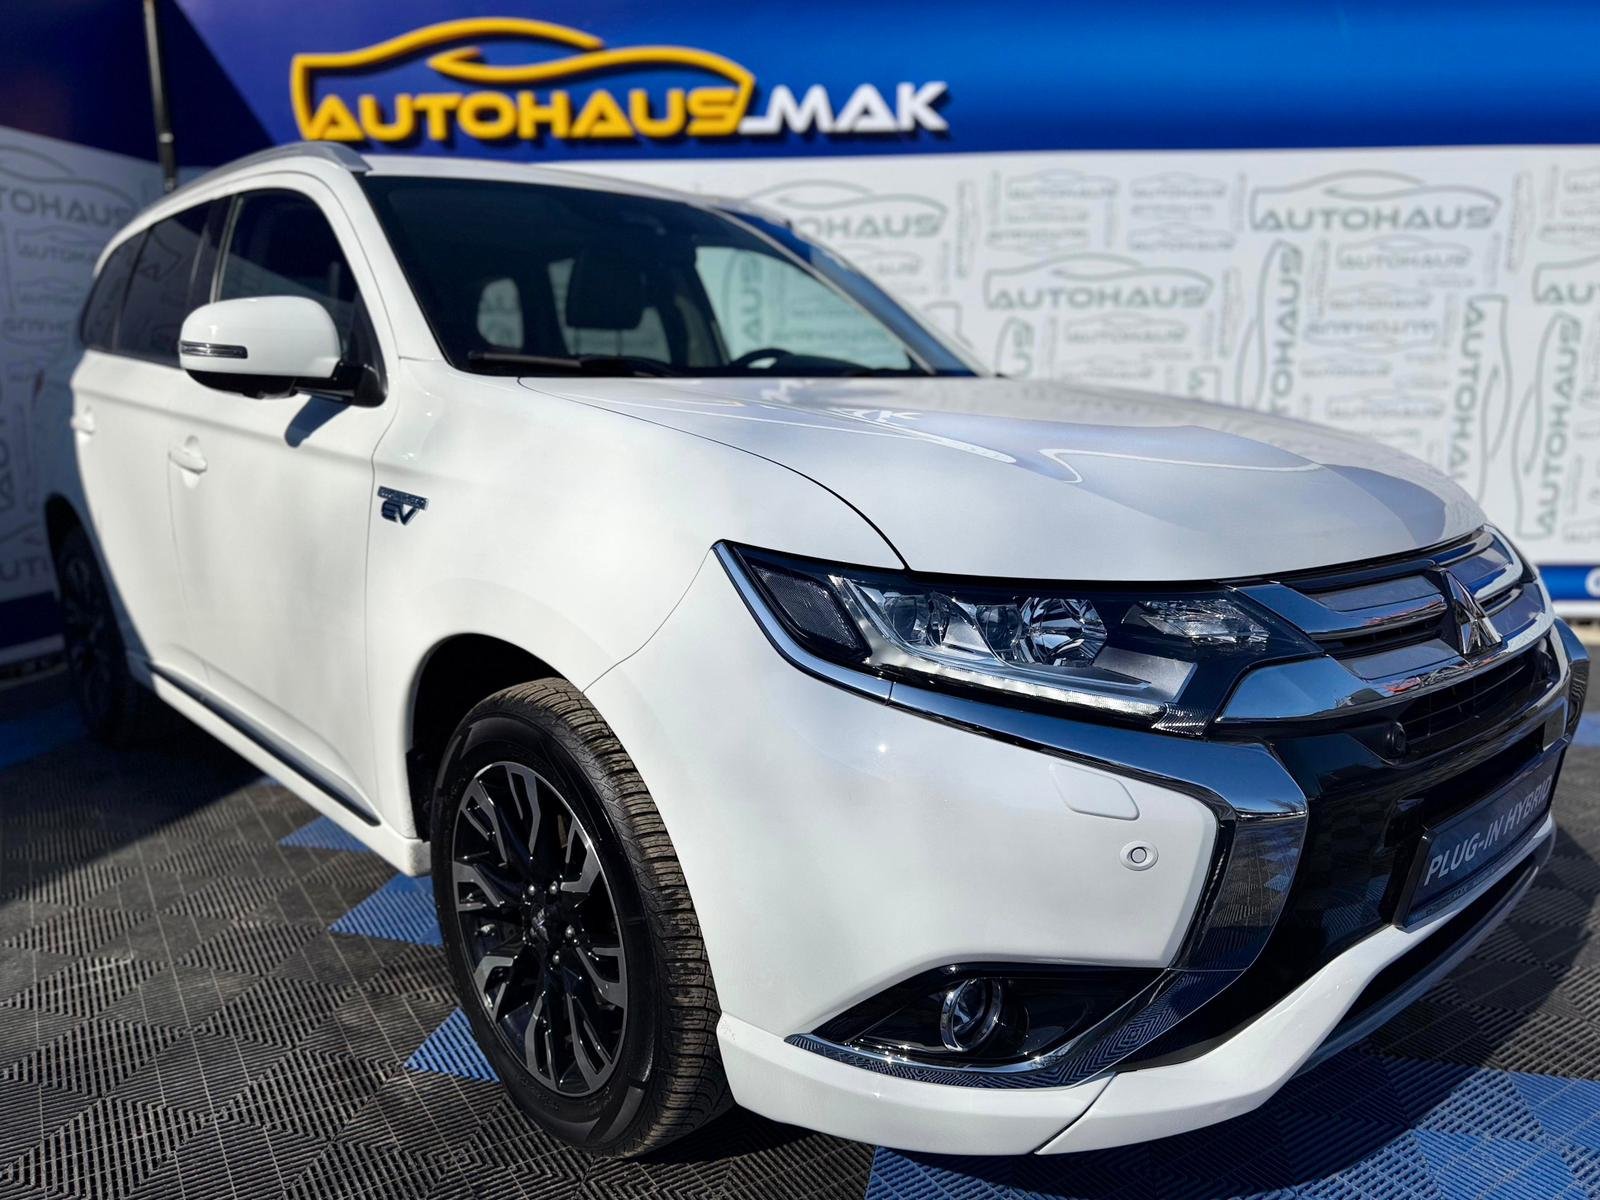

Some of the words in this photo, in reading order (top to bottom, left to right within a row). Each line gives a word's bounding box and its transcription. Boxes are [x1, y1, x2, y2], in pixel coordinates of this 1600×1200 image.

[1252, 205, 1495, 232] AUTOHAUS
[989, 286, 1208, 311] AUTOHAUS
[1538, 316, 1581, 537] AUTOHAUS
[1424, 815, 1505, 887] PLUG-IN
